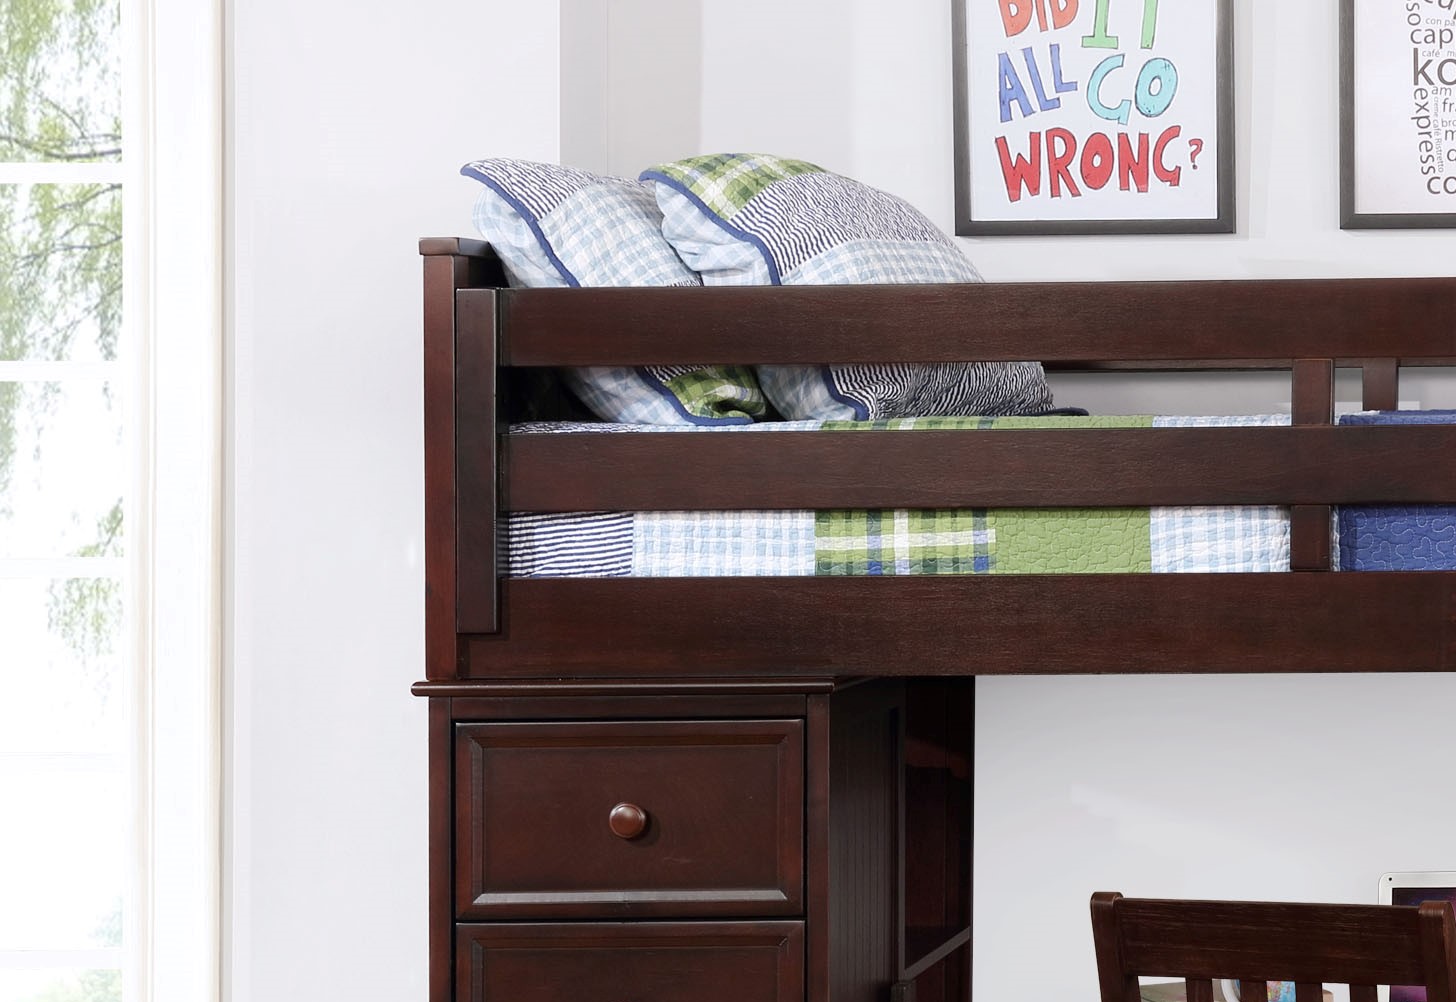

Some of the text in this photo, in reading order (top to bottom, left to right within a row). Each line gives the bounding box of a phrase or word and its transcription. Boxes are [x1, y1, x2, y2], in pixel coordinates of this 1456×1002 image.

[998, 44, 1178, 125] ALL GO
[1431, 86, 1452, 96] am
[995, 125, 1203, 202] WRONG?
[1410, 87, 1436, 175] express
[1435, 138, 1444, 173] Ristretto
